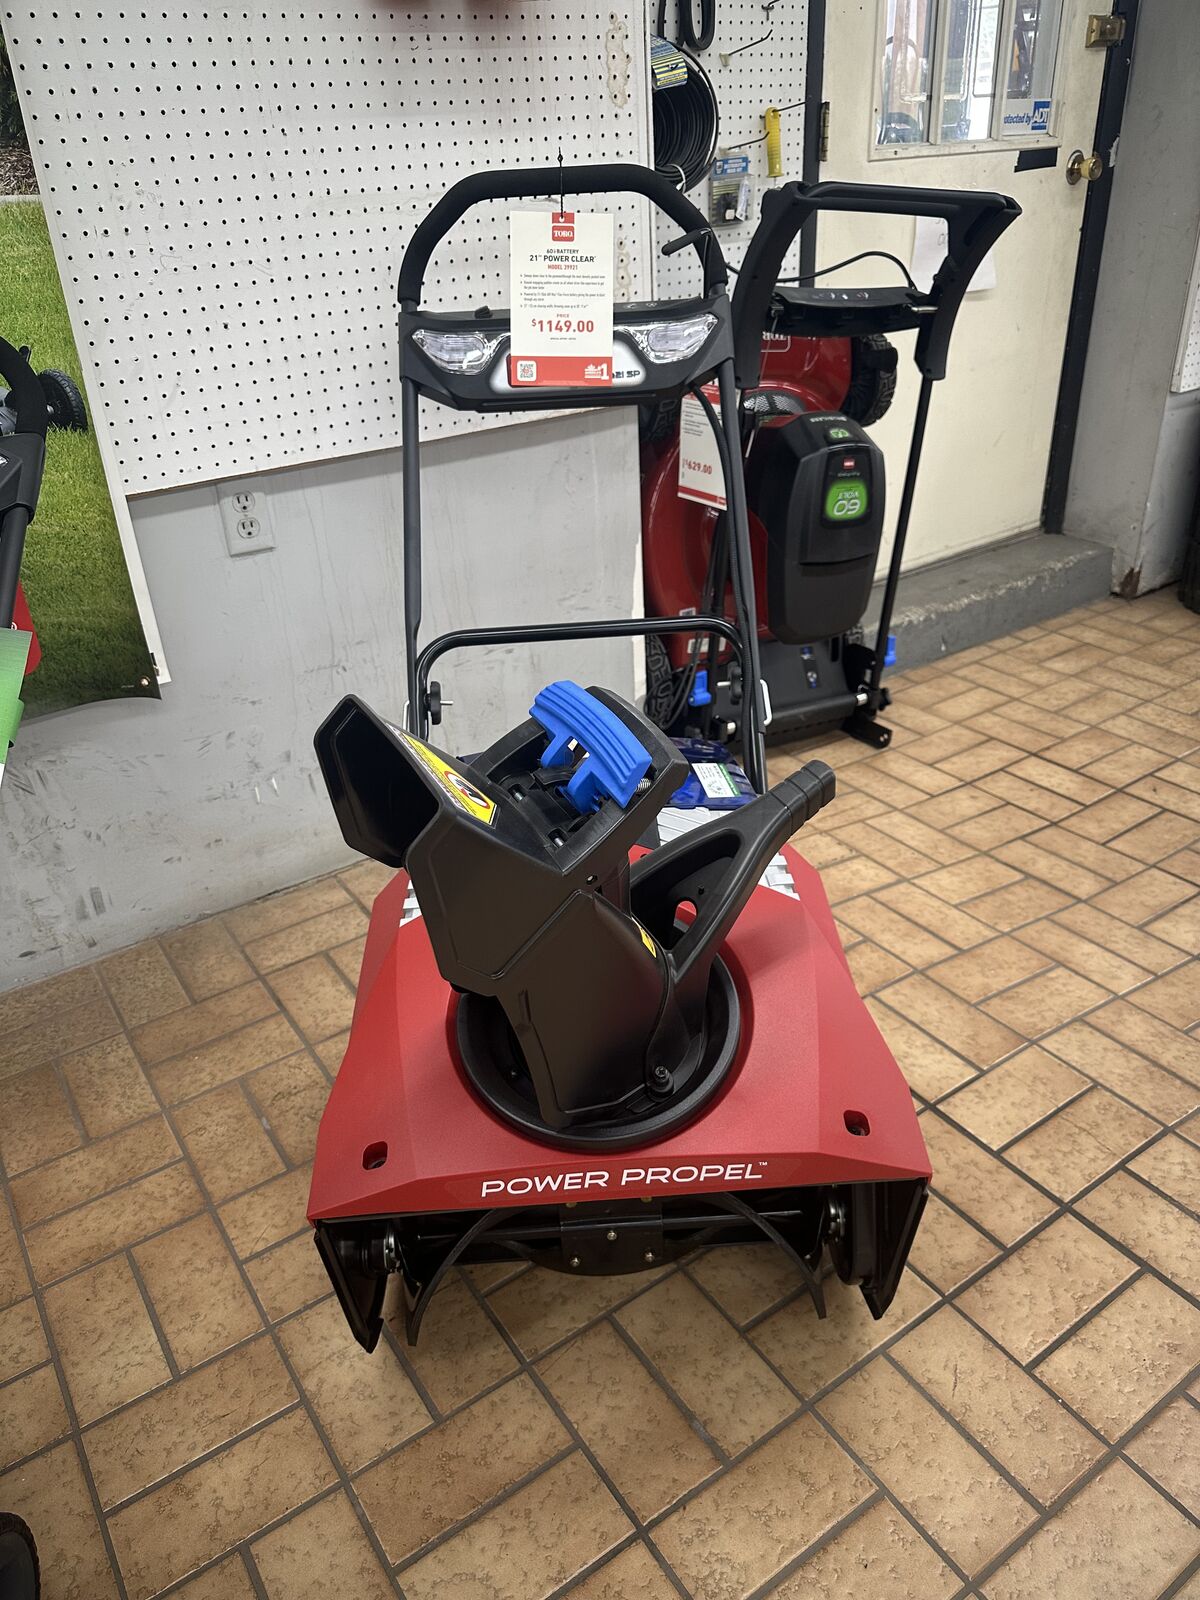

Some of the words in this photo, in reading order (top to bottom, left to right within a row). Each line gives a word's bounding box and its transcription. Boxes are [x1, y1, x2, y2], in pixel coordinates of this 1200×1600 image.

[1025, 113, 1032, 126] by
[1032, 108, 1050, 122] ADT
[531, 318, 594, 332] $1149.00
[626, 370, 640, 378] SP
[838, 490, 859, 500] VOLT
[833, 498, 860, 516] 60
[481, 1170, 610, 1198] POWER
